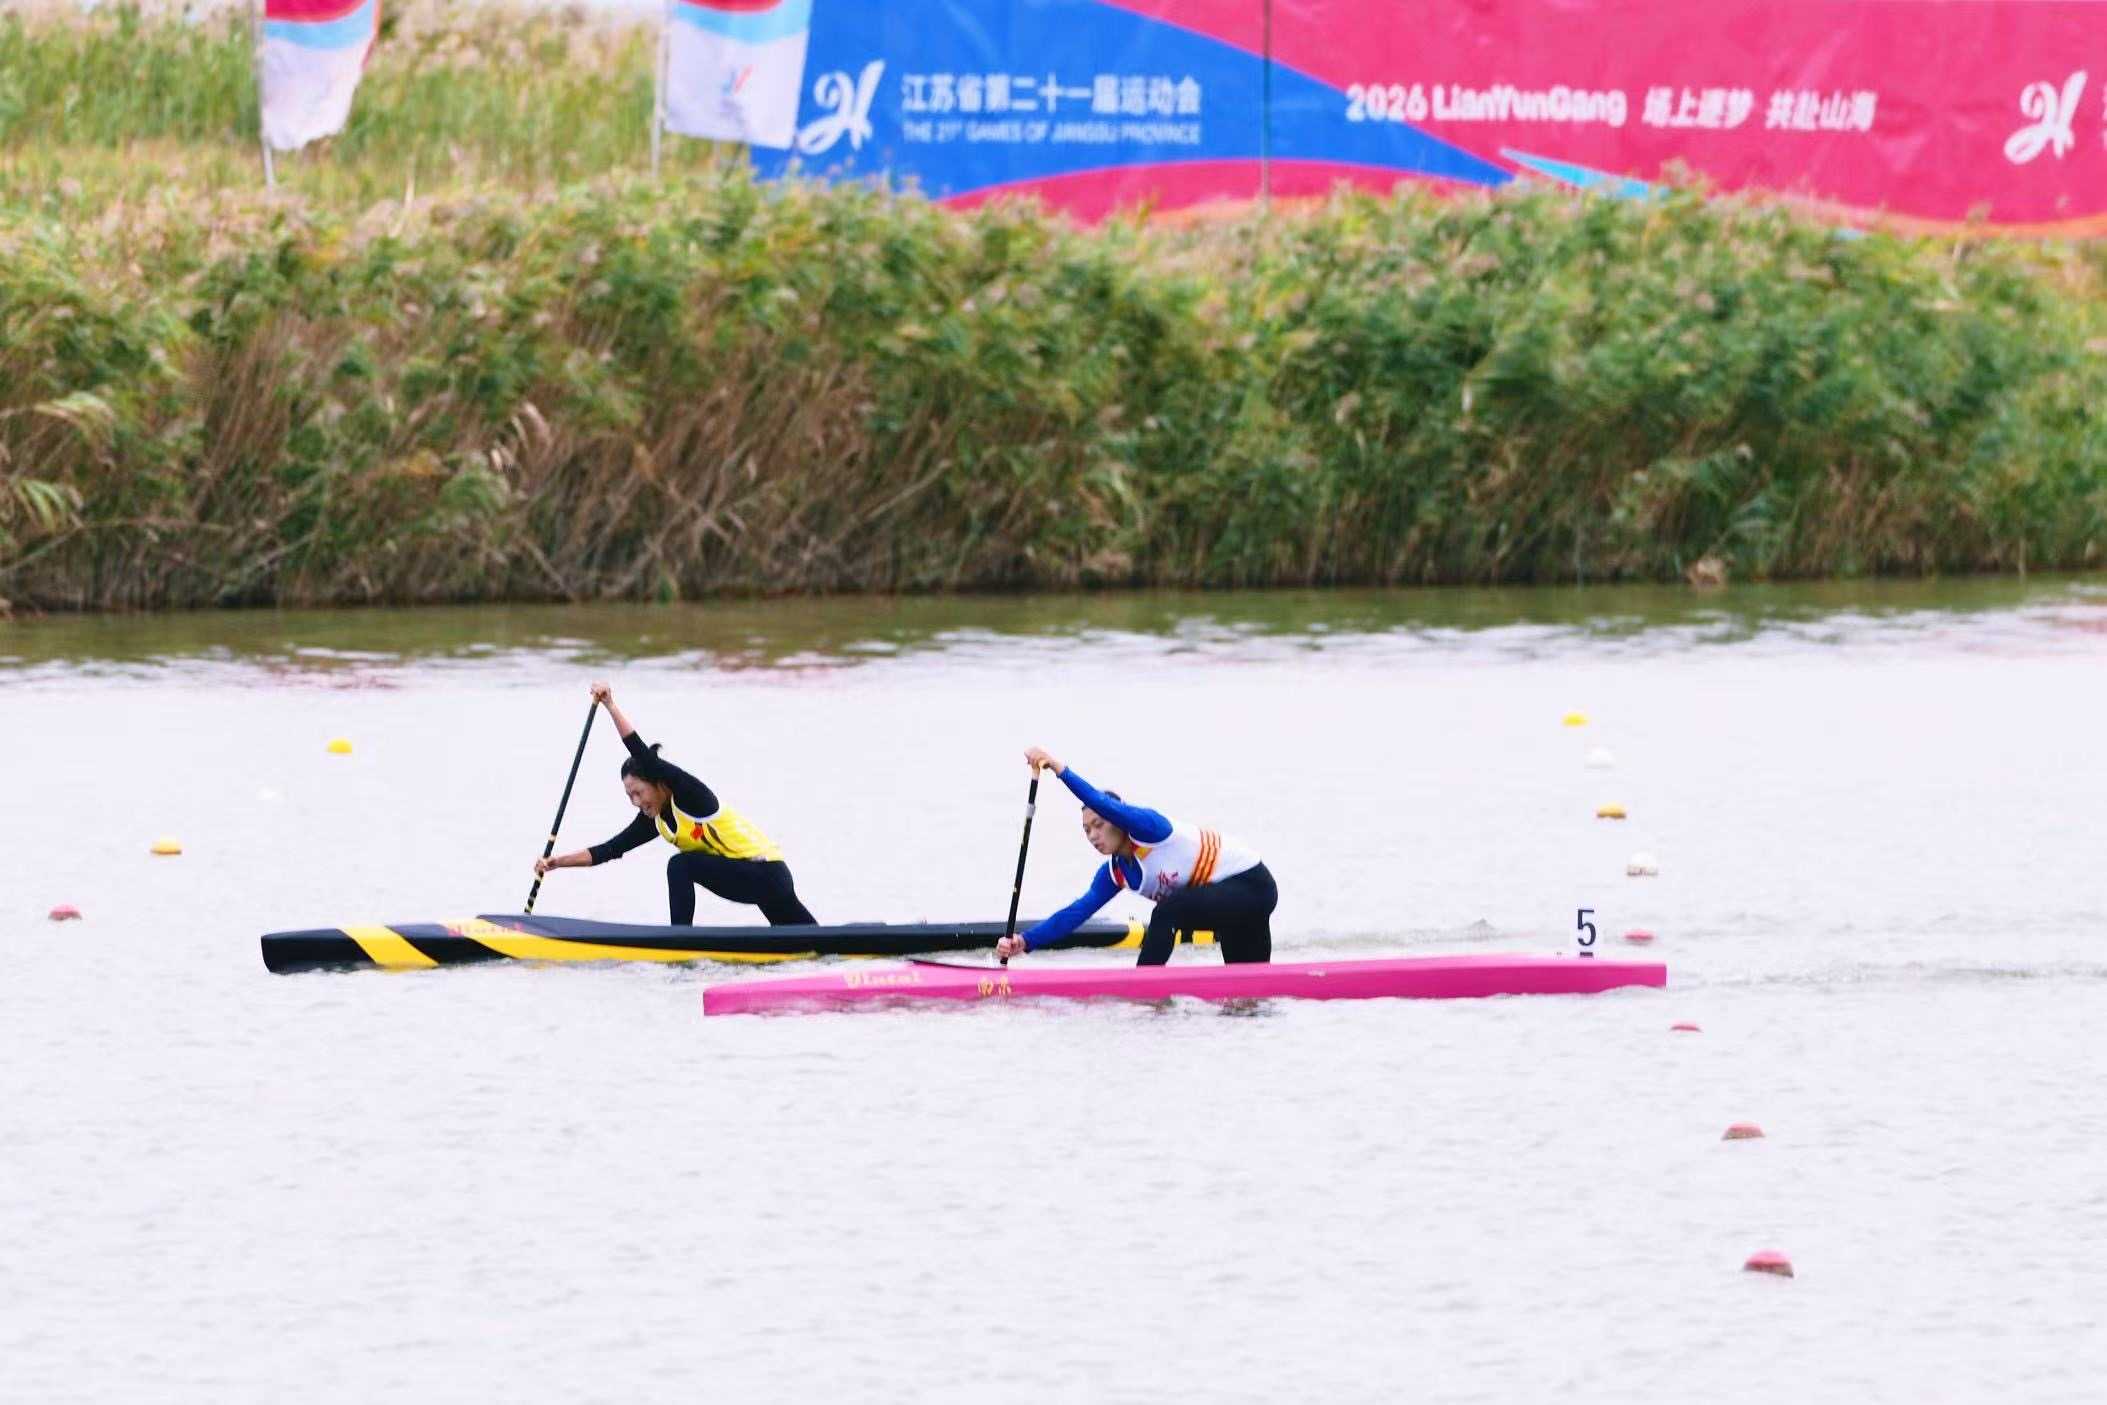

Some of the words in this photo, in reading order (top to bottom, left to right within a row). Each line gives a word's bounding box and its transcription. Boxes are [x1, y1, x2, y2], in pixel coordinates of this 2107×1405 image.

[902, 73, 1200, 115] 江苏省第二十一届运动会
[1346, 84, 1427, 122] 2026
[1432, 85, 1628, 127] LianYunGang
[1577, 908, 1597, 947] 5
